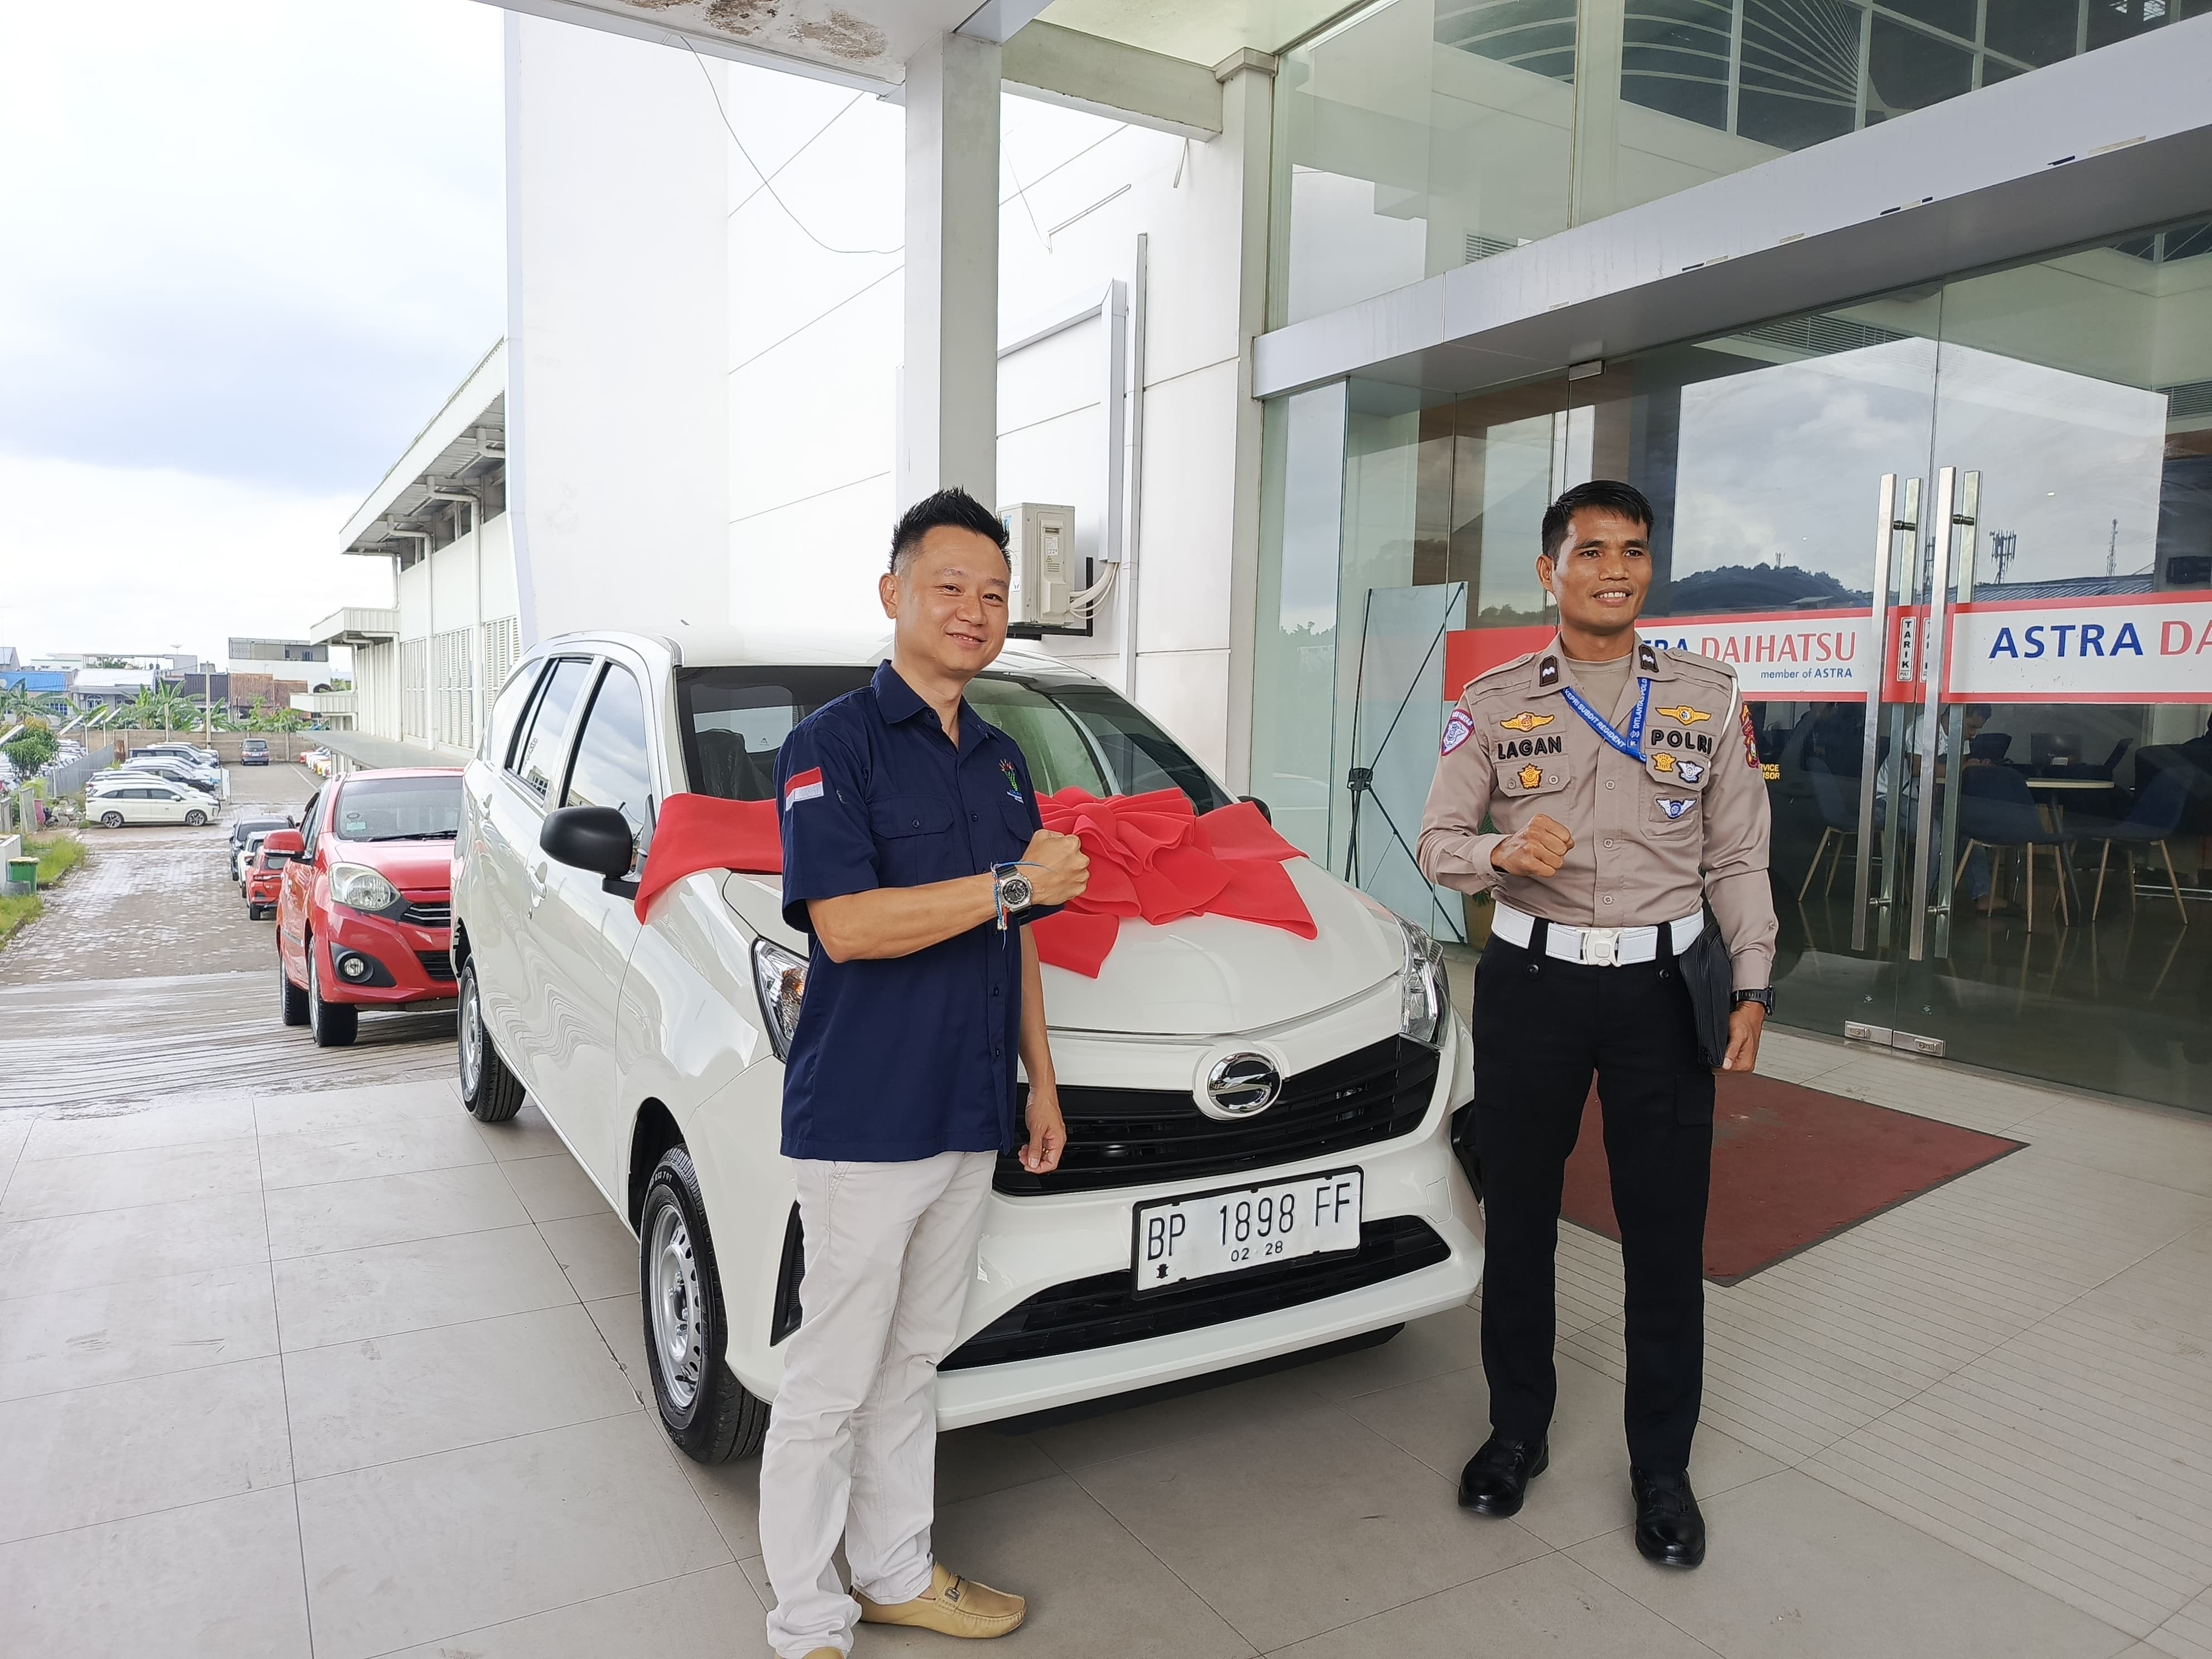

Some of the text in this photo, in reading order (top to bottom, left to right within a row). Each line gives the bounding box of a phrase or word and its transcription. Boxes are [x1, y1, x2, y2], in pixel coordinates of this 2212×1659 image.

[1701, 632, 1856, 663] DAIHATSU
[1901, 621, 1912, 668] TARIK
[1988, 622, 2144, 658] ASTRA
[1760, 668, 1852, 678] member of ASTRA
[1564, 689, 1626, 748] KEPRI SUBDIT REGIDENT
[1498, 735, 1562, 760] LAGAN
[1651, 729, 1713, 755] POLRI
[1147, 1182, 1351, 1261] BP 1898 FF
[1230, 1240, 1283, 1262] 02 28
